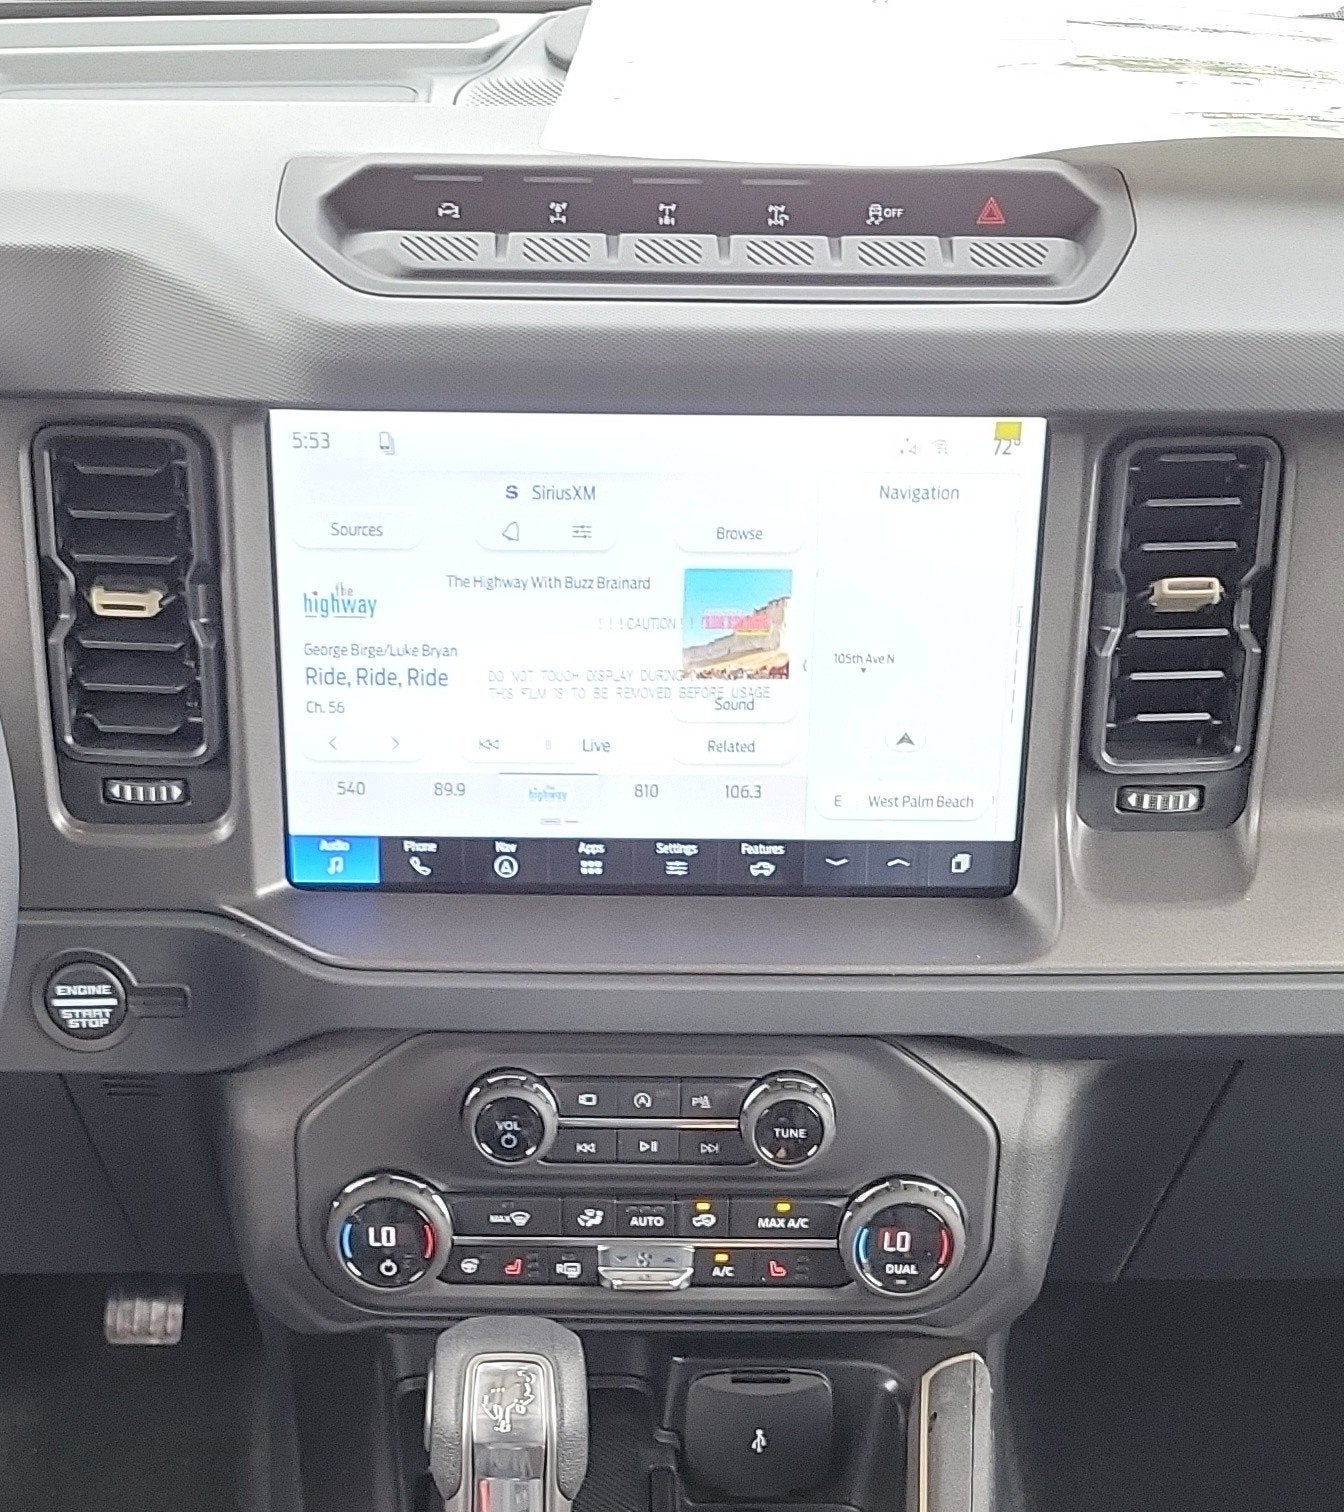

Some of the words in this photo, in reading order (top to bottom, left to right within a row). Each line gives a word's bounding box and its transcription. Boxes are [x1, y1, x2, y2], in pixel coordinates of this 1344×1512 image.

[884, 207, 904, 218] OFF
[292, 432, 331, 449] 5:53
[532, 485, 596, 501] SiriusXM
[879, 485, 960, 502] Navigation
[330, 523, 384, 537] Sources
[716, 526, 763, 541] Browse
[446, 575, 470, 589] The
[473, 576, 529, 593] Highway
[531, 576, 562, 589] With
[564, 576, 595, 590] Buzz
[596, 576, 651, 591] Brainard
[303, 591, 377, 618] highway
[304, 644, 348, 658] George
[421, 644, 458, 659] Bryan
[834, 652, 863, 665] 105th
[865, 653, 886, 665] Ave
[887, 653, 896, 665] N
[305, 667, 351, 688] Ride,
[356, 667, 402, 688] Ride,
[407, 667, 449, 687] Ride
[306, 701, 325, 714] Ch.
[328, 701, 345, 714] 56
[714, 698, 754, 712] Sound
[582, 738, 611, 752] Live
[707, 741, 755, 754] Related
[337, 782, 366, 796] 540
[434, 782, 466, 797] 89.9
[634, 784, 659, 798] 810
[724, 784, 762, 799] 106.3
[834, 795, 842, 807] E
[868, 795, 900, 808] West
[902, 795, 934, 808] Palm
[937, 795, 974, 808] Beach
[319, 839, 350, 852] Audio
[403, 840, 438, 853] Phone
[495, 841, 518, 853] Nav
[578, 842, 606, 855] Apps
[655, 842, 699, 857] Settings
[741, 842, 786, 856] Features
[55, 985, 112, 995] ENGINE
[60, 1009, 113, 1018] START
[67, 1019, 110, 1028] STOP
[495, 1121, 521, 1131] VOL
[773, 1128, 807, 1139] TUNE
[630, 1216, 664, 1227] AUTO
[758, 1217, 786, 1228] MAX
[787, 1217, 809, 1229] A/C
[712, 1266, 734, 1277] A/C
[885, 1264, 919, 1275] DUAL
